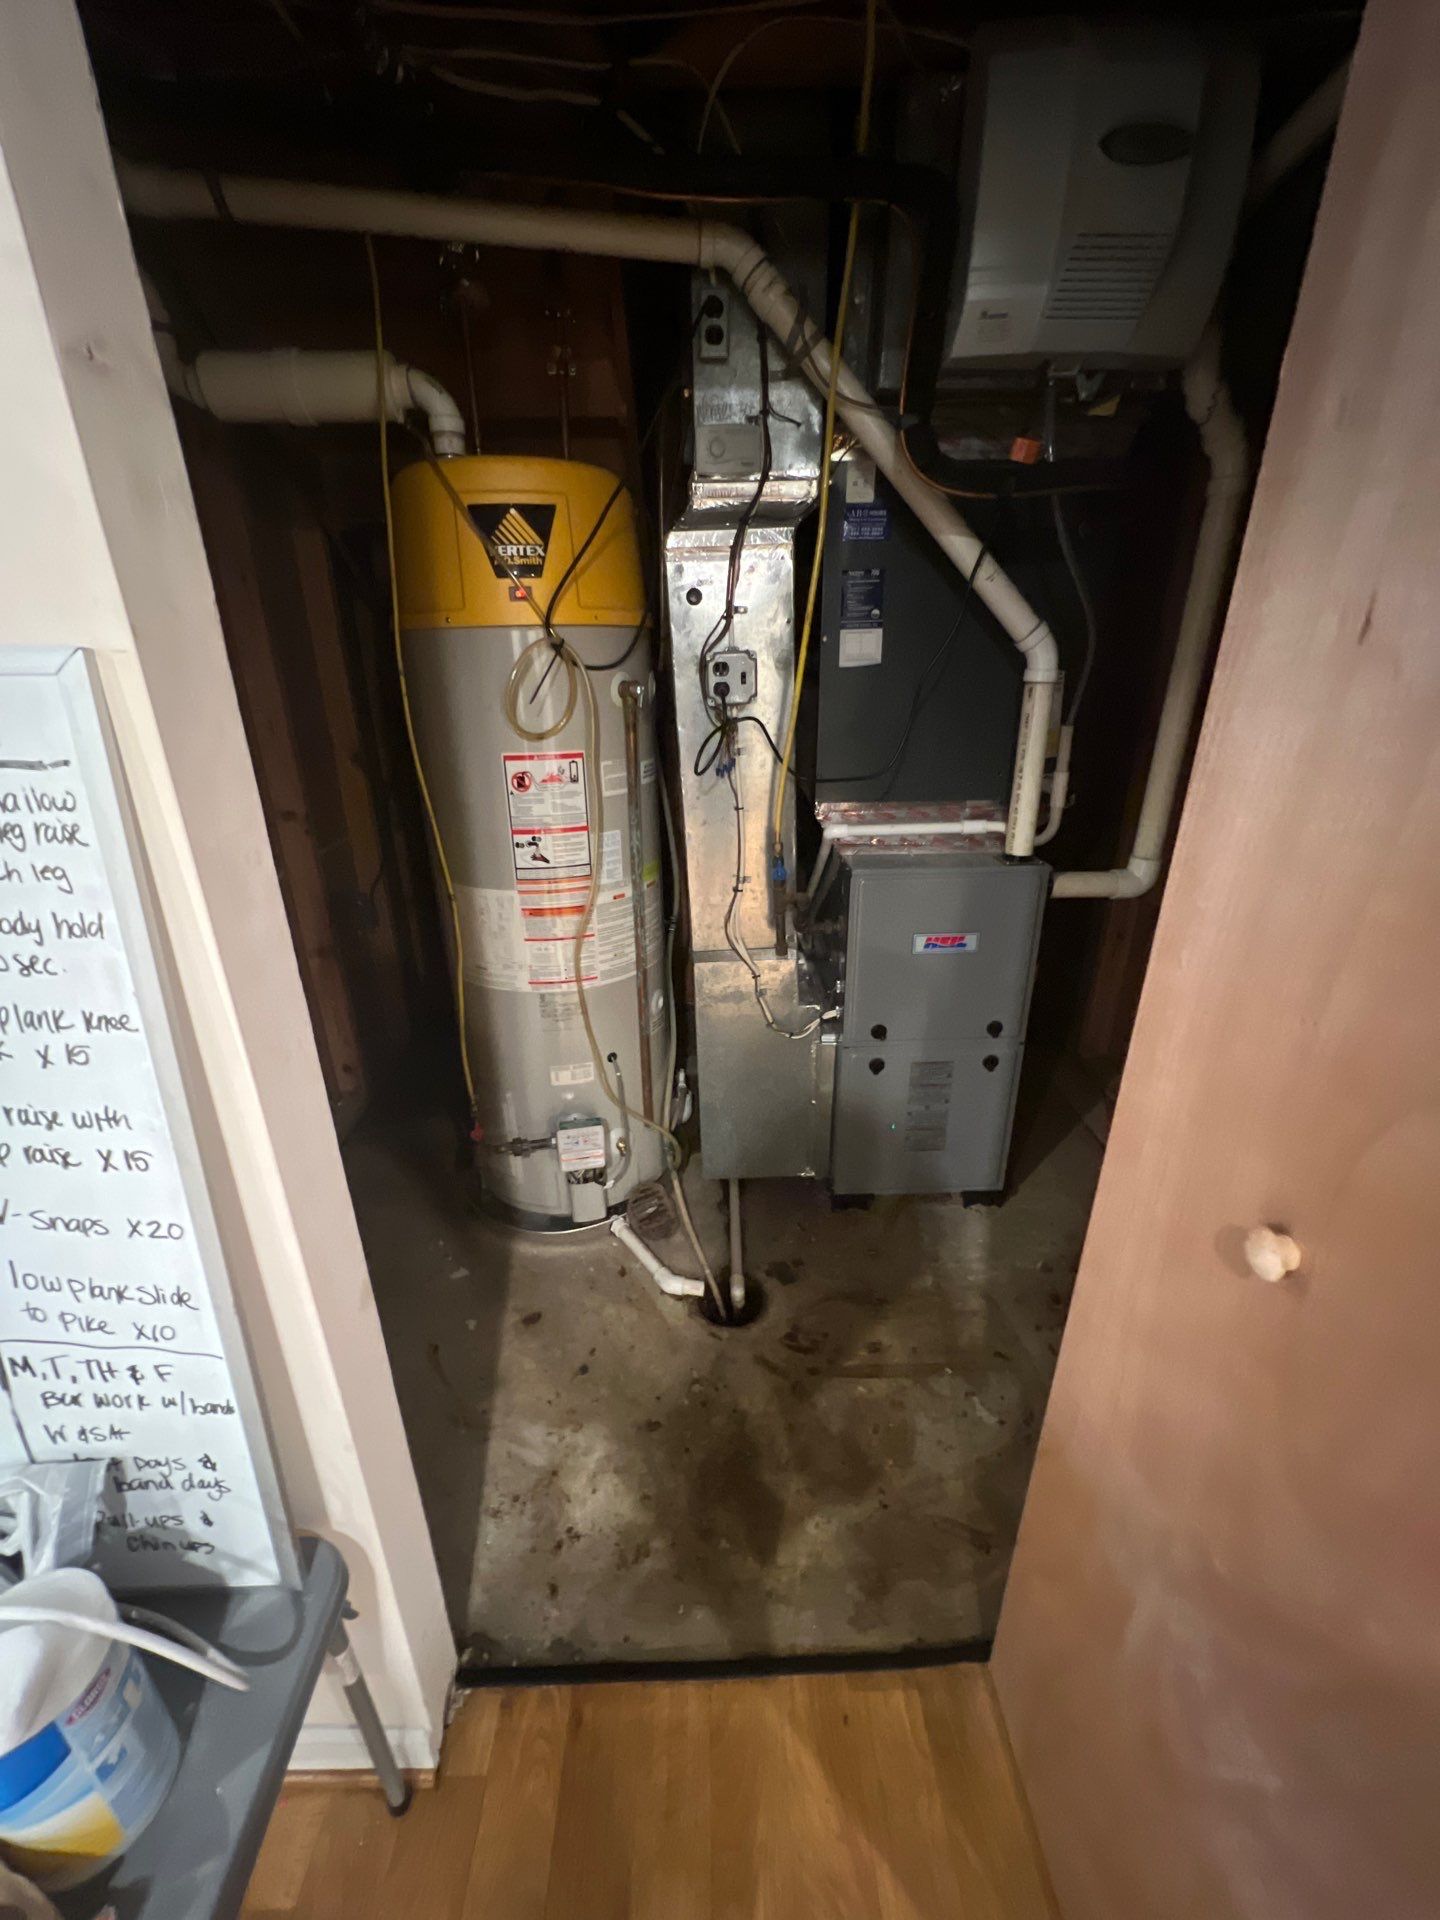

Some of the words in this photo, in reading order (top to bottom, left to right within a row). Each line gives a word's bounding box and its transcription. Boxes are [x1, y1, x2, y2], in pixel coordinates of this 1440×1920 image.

[34, 818, 90, 847] raise
[31, 863, 74, 894] leg
[51, 911, 105, 940] hold
[82, 1010, 139, 1033] knee
[2, 1104, 64, 1131] raise
[23, 1143, 82, 1171] raise
[154, 1364, 174, 1382] F
